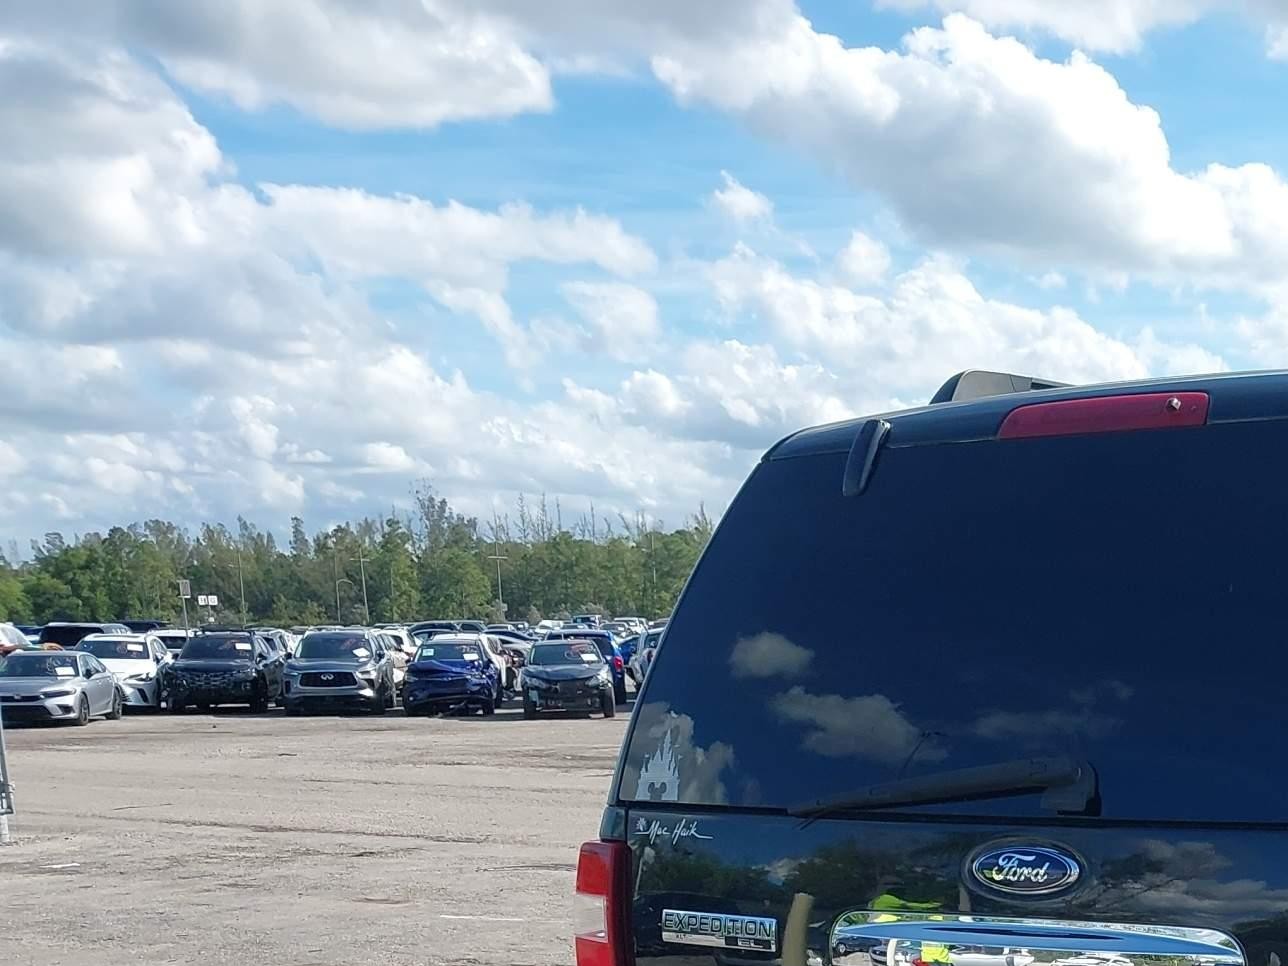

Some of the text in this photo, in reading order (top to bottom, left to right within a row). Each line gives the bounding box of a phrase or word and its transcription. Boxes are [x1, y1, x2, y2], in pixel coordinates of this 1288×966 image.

[672, 818, 713, 845] Haik
[992, 852, 1051, 883] Ford
[663, 912, 774, 938] EXPEDITION
[738, 938, 764, 949] EL
